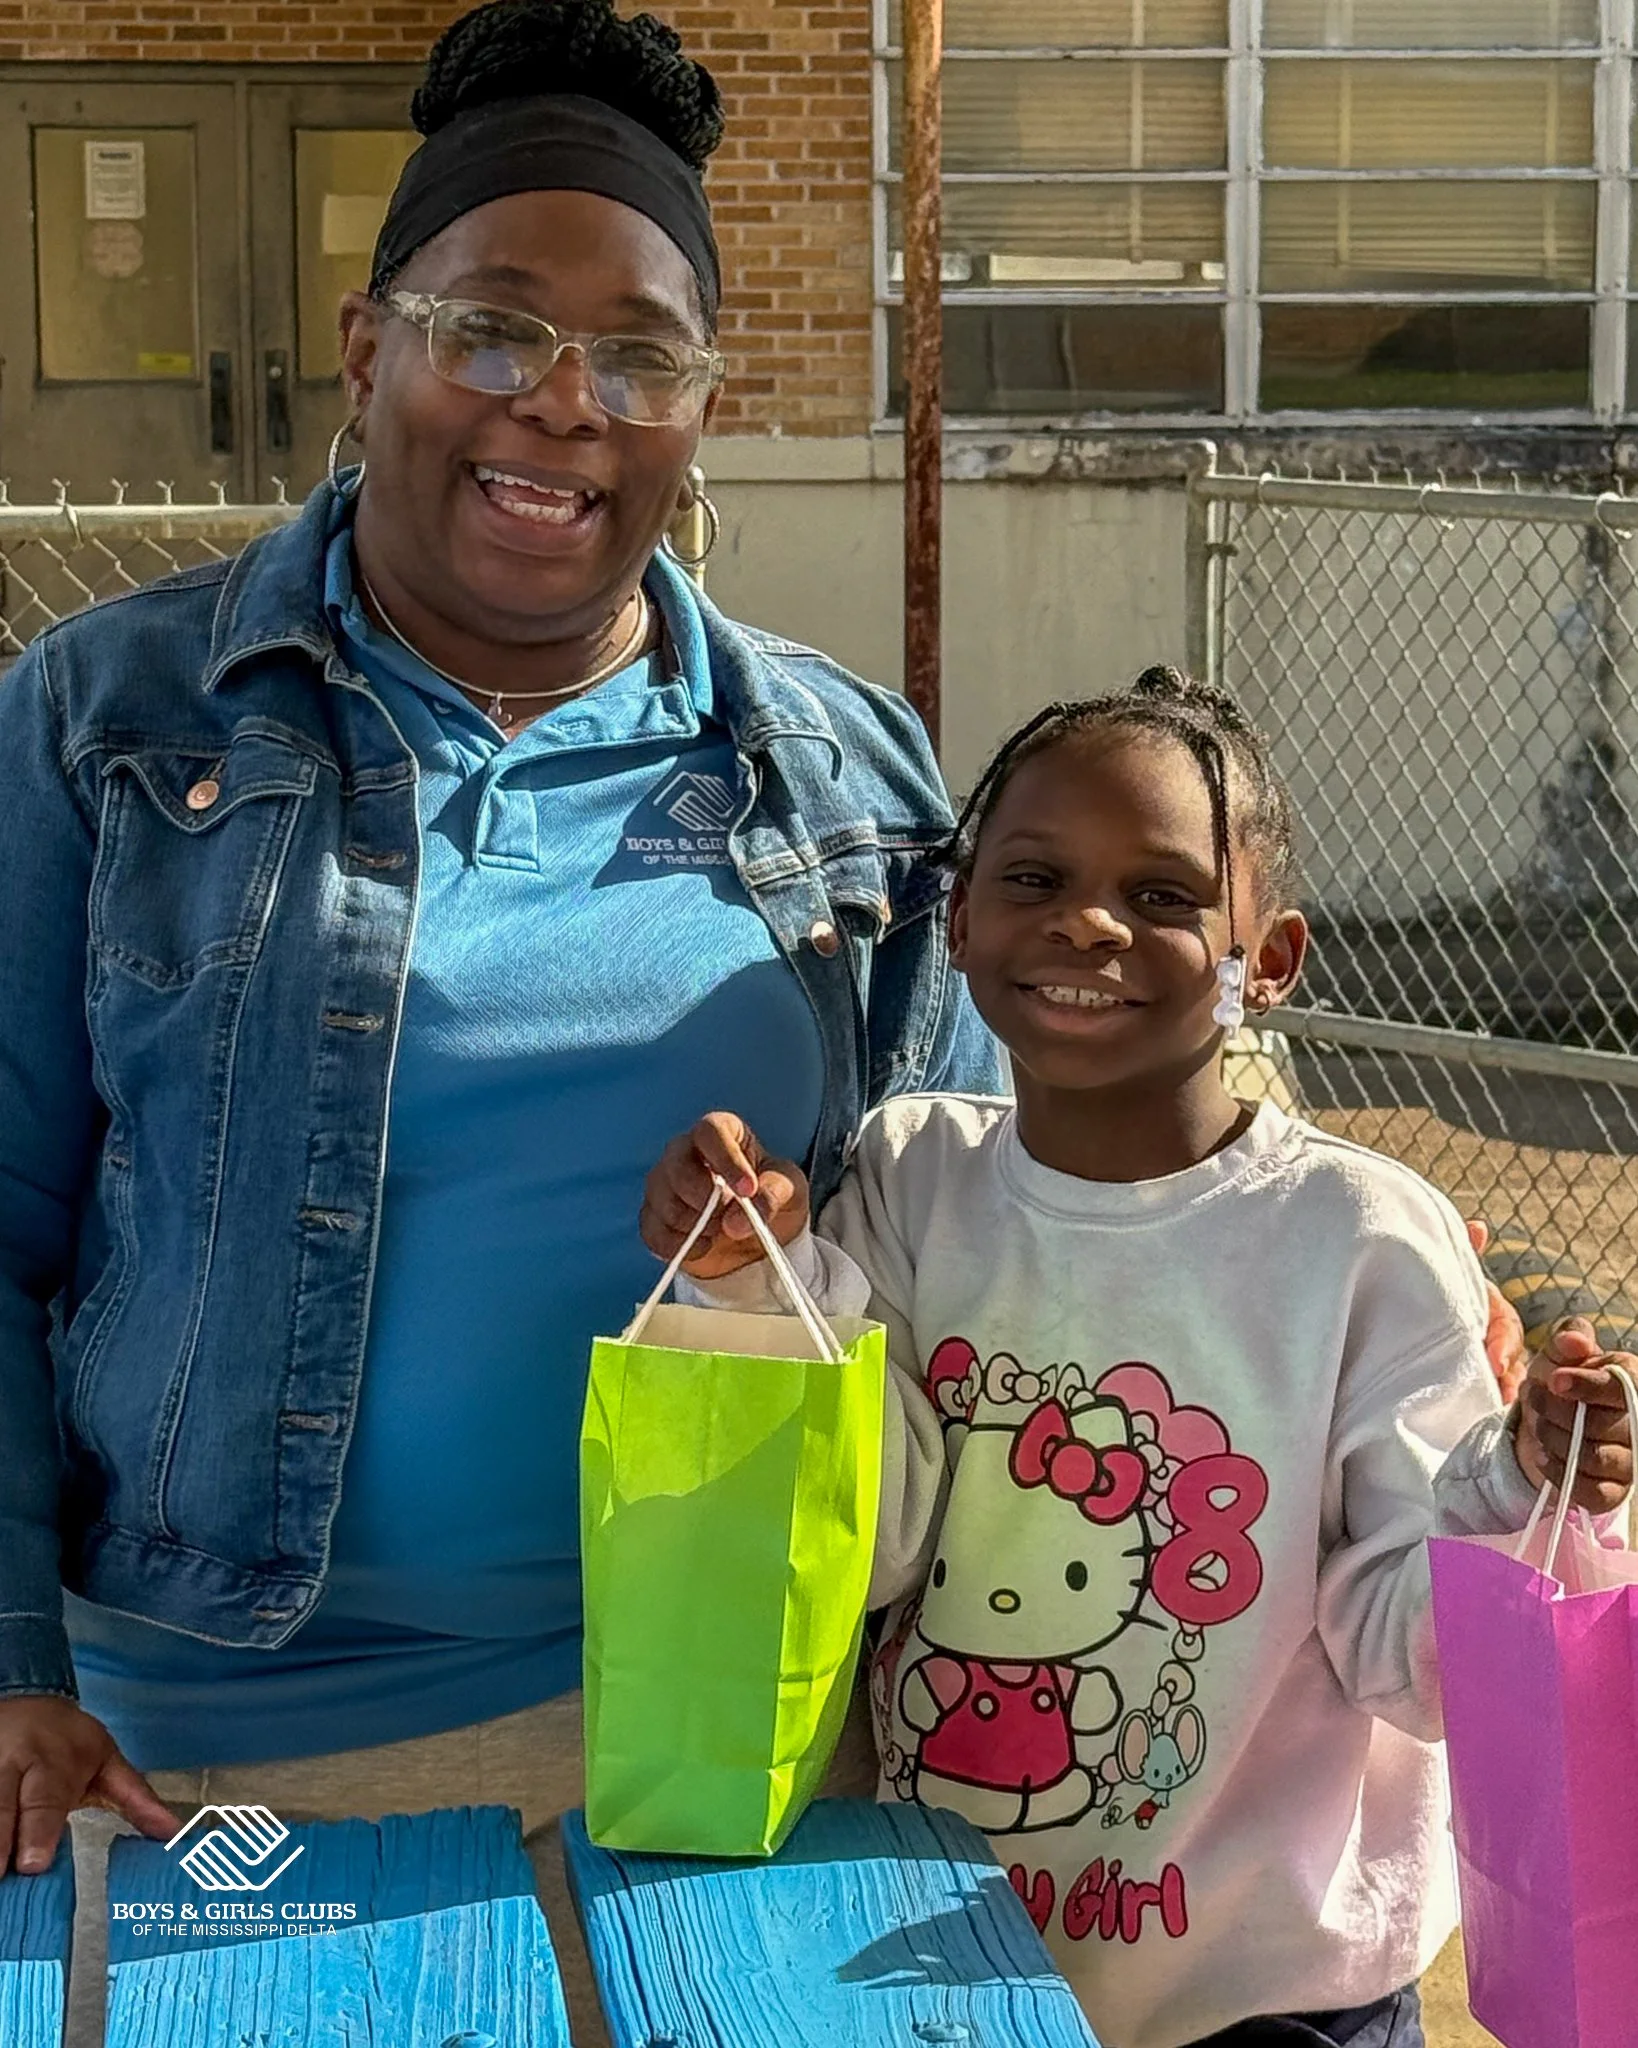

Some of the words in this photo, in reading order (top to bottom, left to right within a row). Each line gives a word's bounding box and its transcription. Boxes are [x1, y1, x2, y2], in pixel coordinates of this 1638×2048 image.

[625, 838, 675, 851] BOYS
[677, 838, 696, 851] &
[642, 854, 660, 865] OF
[662, 854, 690, 865] THE
[1150, 1453, 1269, 1626] 8
[1062, 1855, 1189, 1944] Girl
